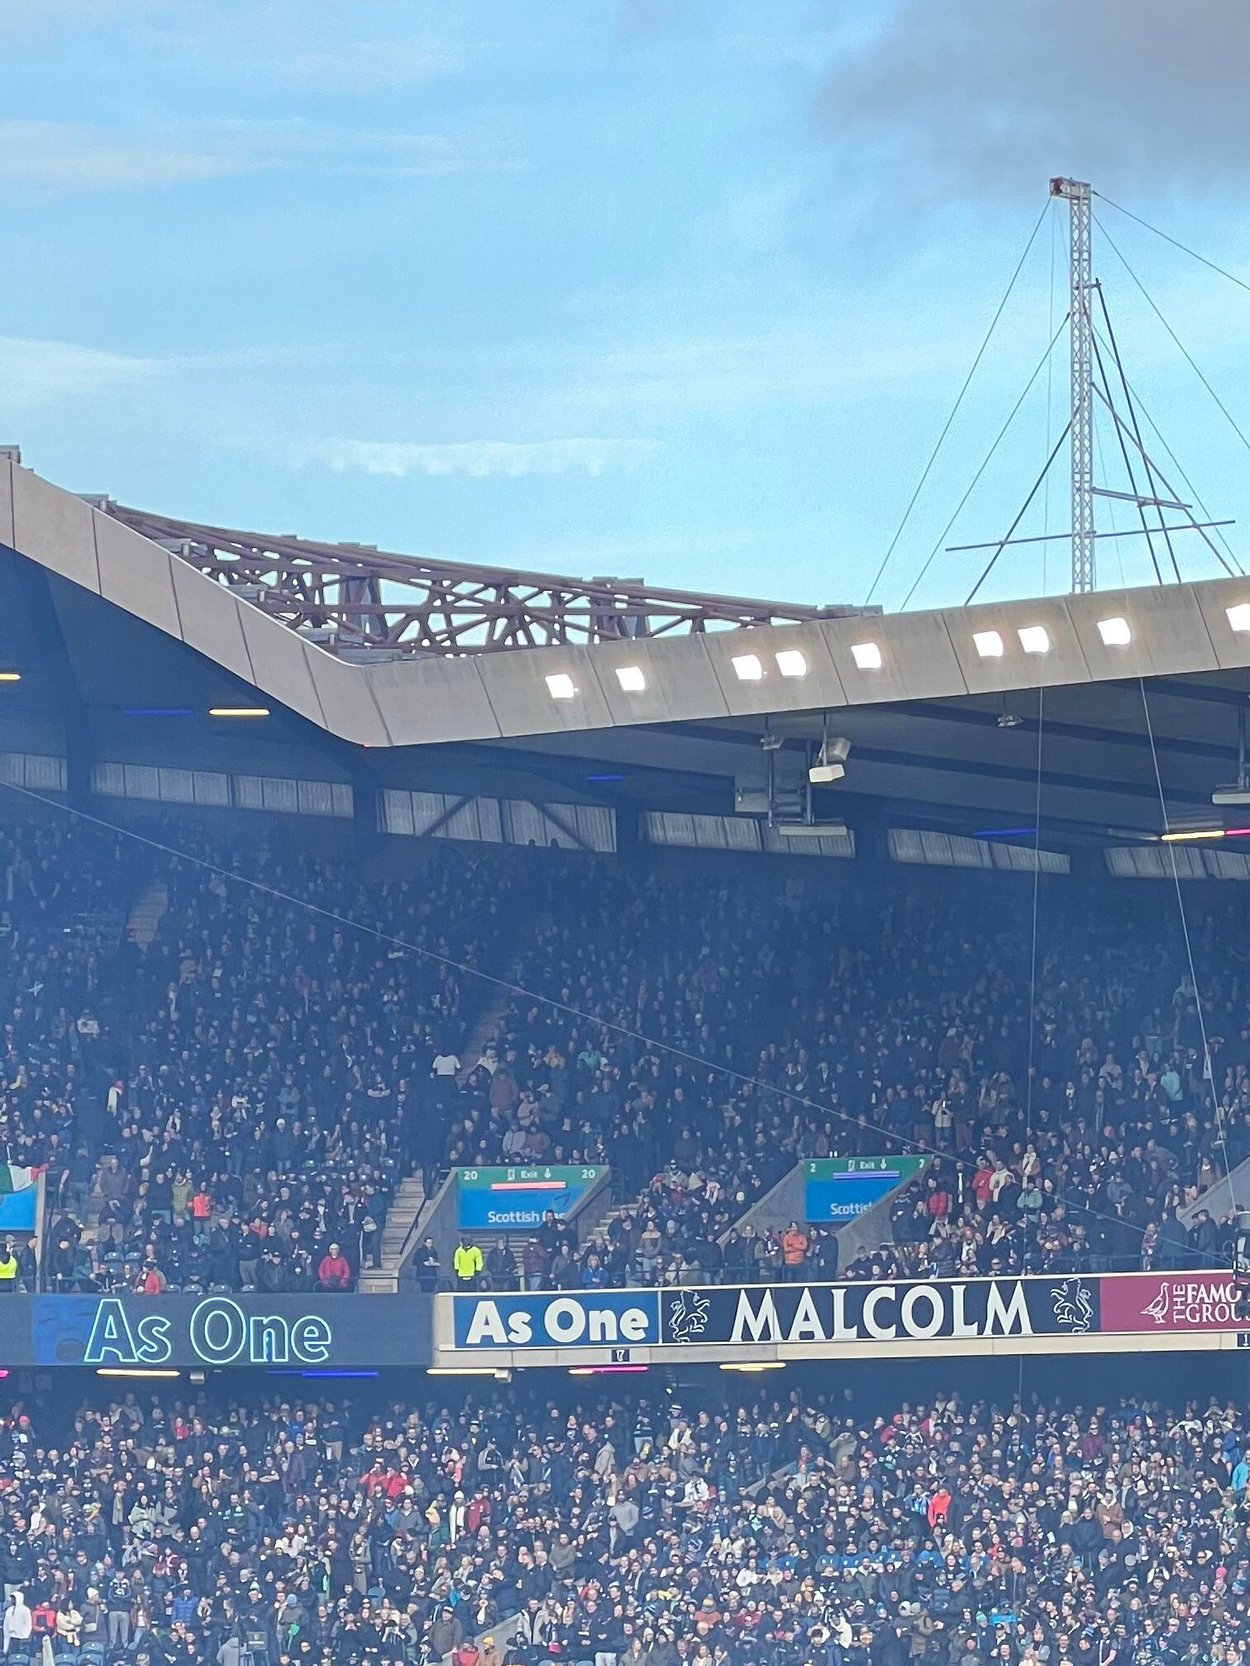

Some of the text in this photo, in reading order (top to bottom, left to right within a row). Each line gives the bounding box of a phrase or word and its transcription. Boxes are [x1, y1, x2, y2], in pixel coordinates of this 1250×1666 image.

[464, 1169, 596, 1181] 20 Exit 20
[810, 1163, 816, 1173] 2
[860, 1161, 875, 1170] Exit
[488, 1210, 540, 1223] Scottish
[831, 1202, 872, 1215] Scottis
[730, 1280, 1034, 1342] MALCOLM
[1173, 1284, 1186, 1323] THE
[83, 1297, 332, 1364] As One
[466, 1297, 649, 1344] As One
